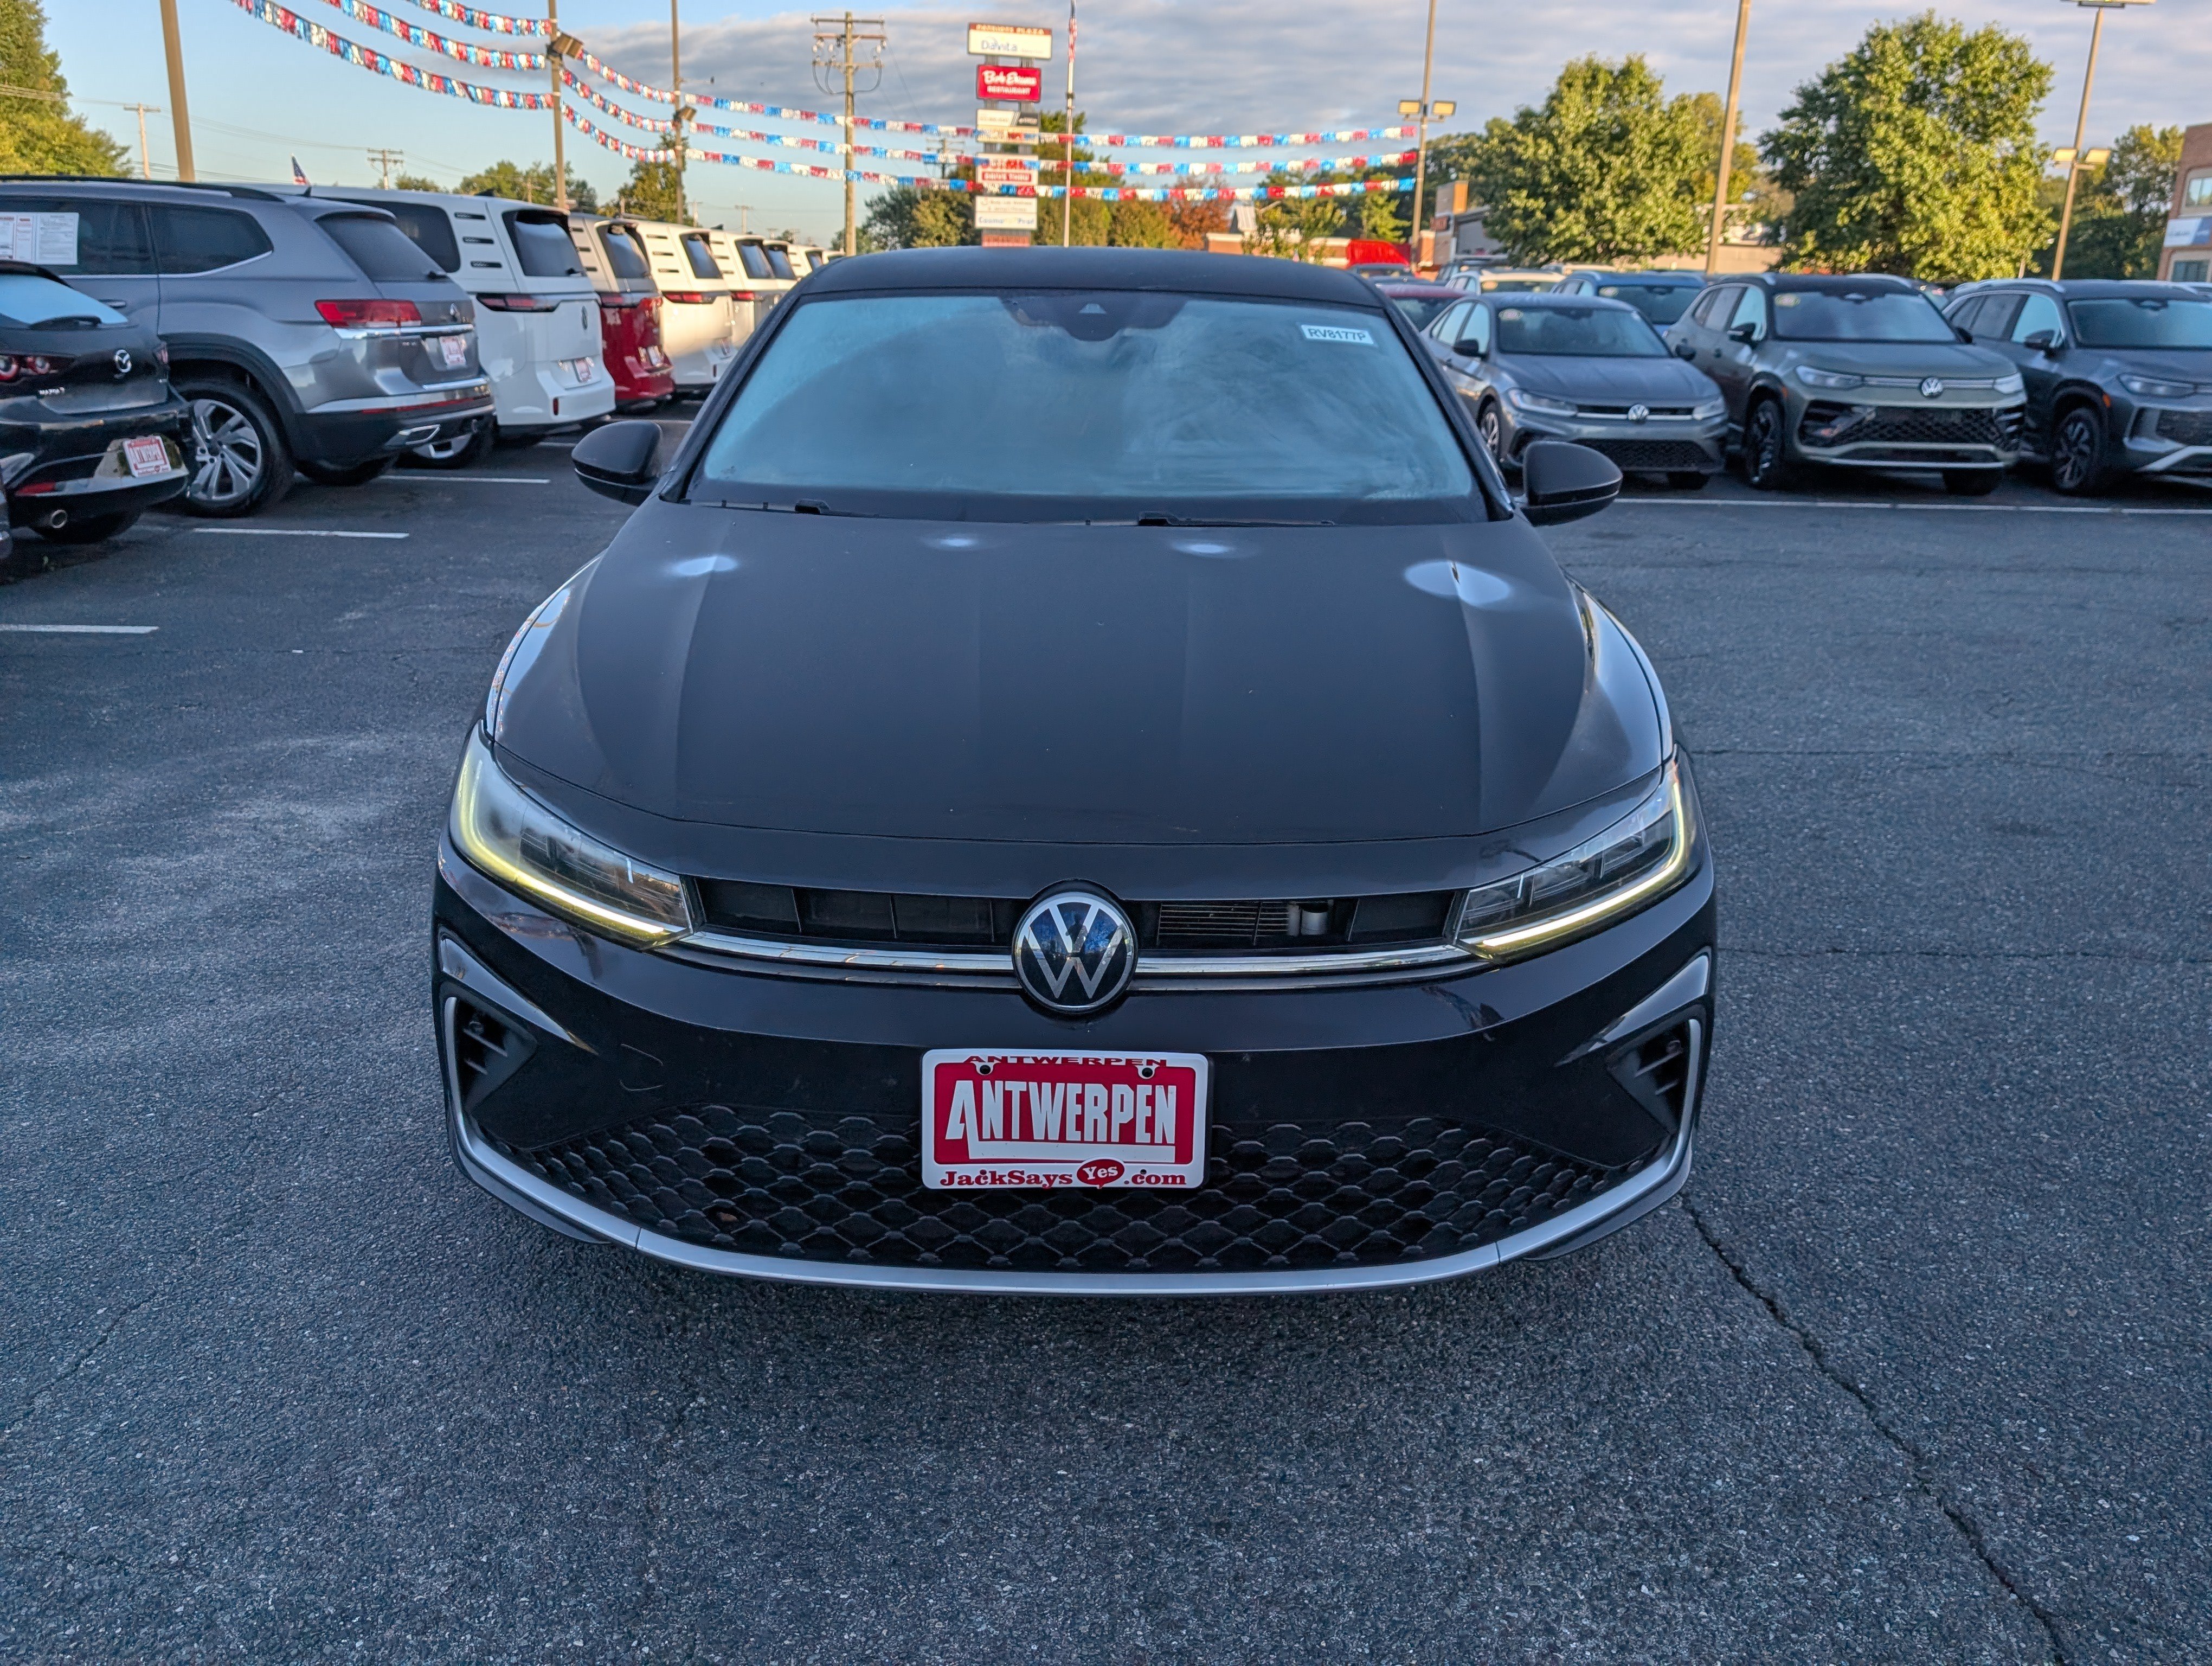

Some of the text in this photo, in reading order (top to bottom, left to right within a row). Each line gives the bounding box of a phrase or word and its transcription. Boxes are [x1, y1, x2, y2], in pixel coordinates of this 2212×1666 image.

[981, 40, 1018, 52] DaVita
[982, 70, 1037, 86] Bob Evans
[1308, 328, 1366, 341] RV8177P
[963, 1055, 1167, 1067] ANTWERPEN
[945, 1080, 1176, 1163] ANTWERPEN
[940, 1165, 1187, 1189] JackSays Yes .com
